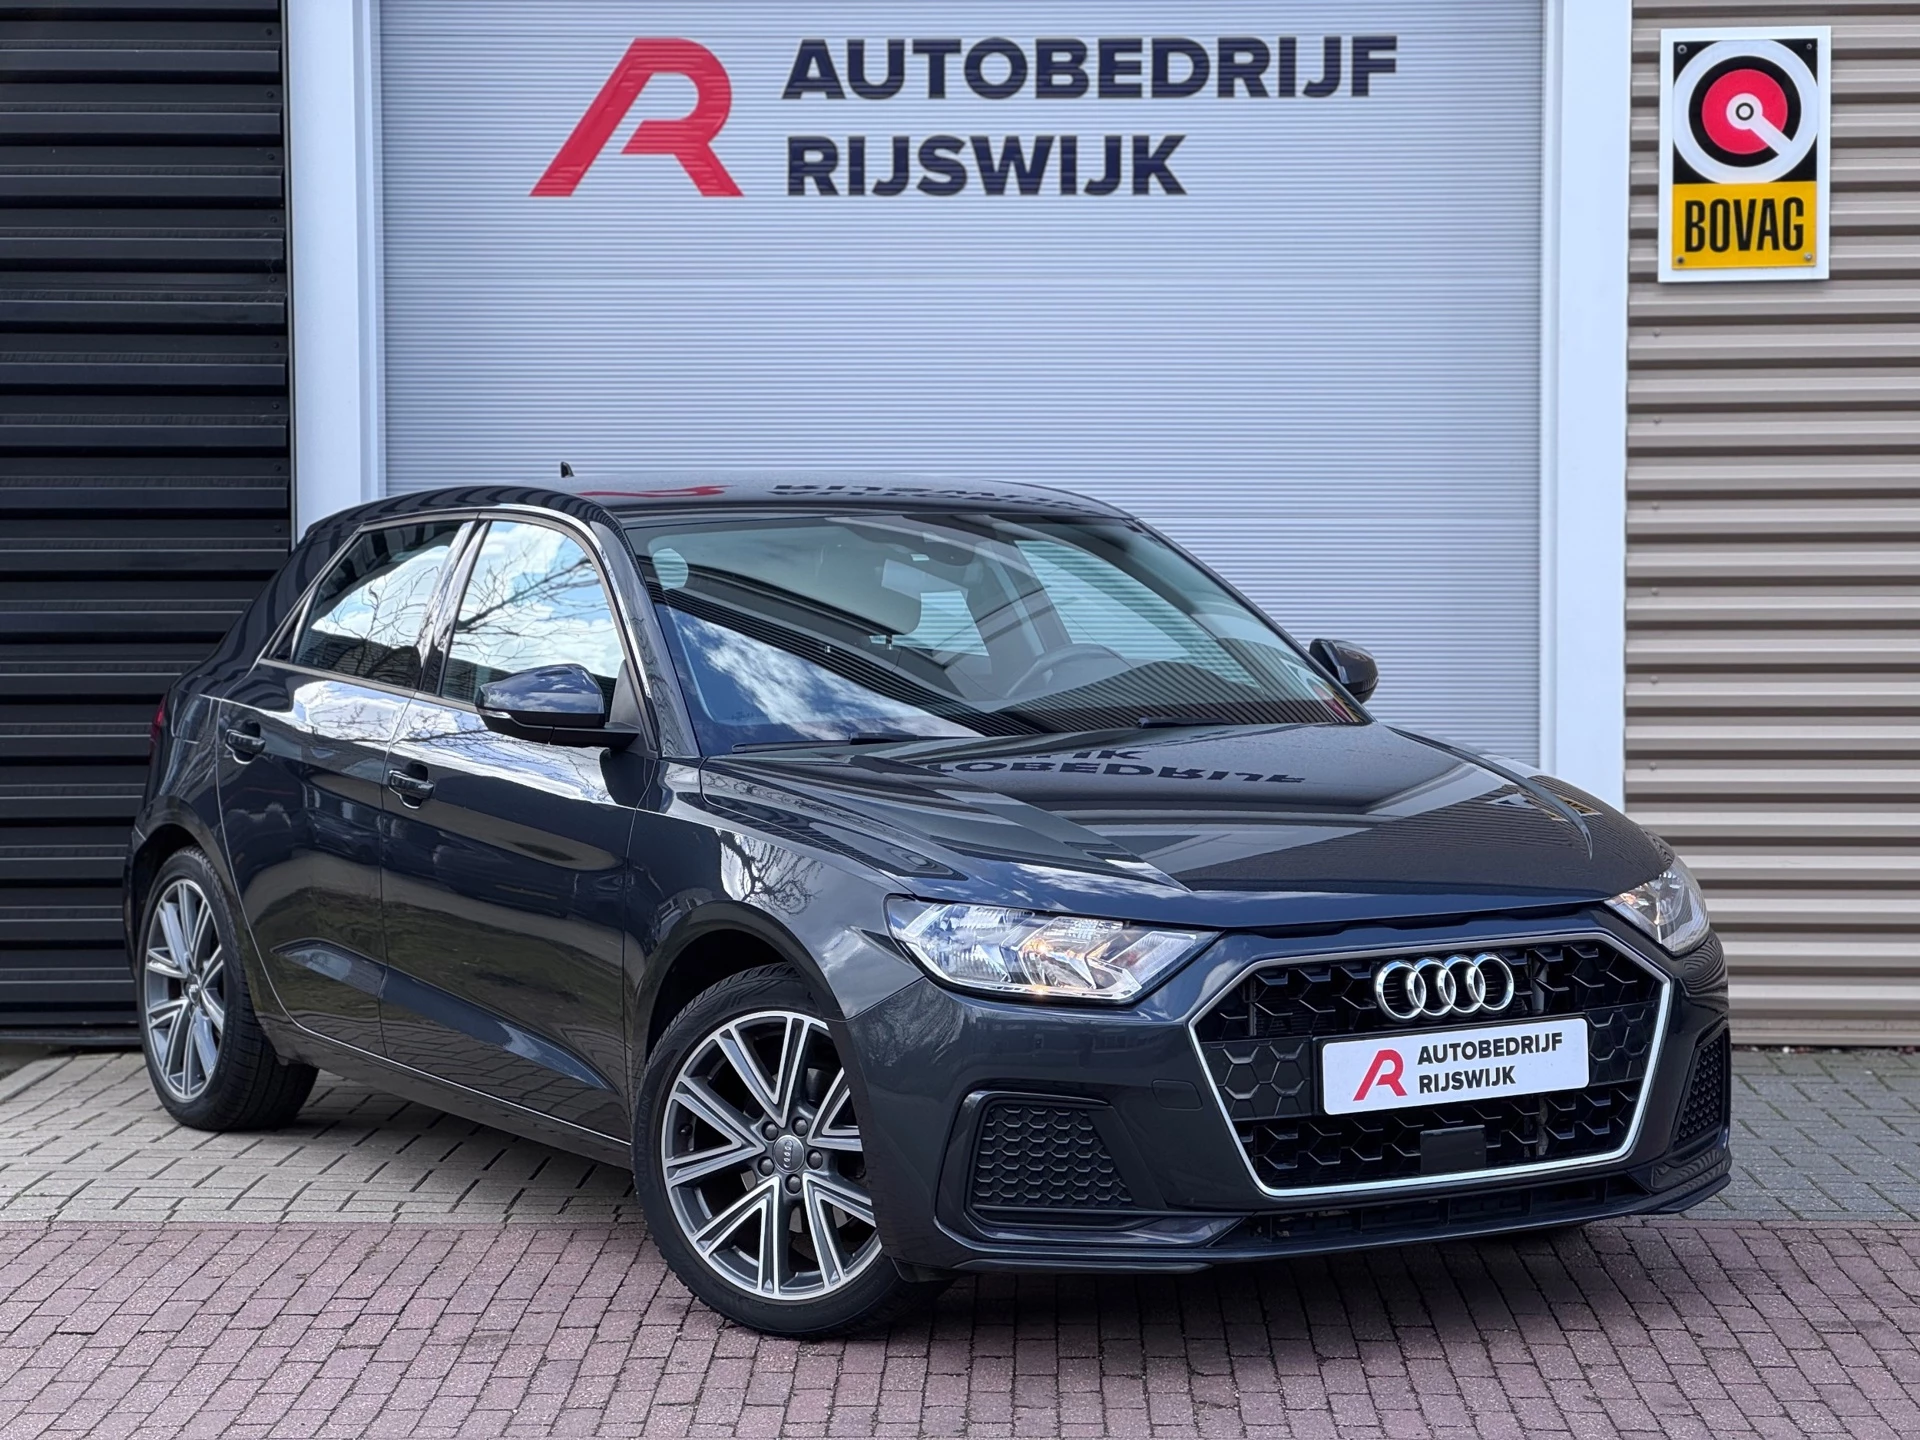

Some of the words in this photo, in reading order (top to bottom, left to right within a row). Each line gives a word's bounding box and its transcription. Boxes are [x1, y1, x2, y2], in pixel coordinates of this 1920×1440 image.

[782, 35, 1398, 100] AUTOBEDRIJF
[787, 135, 1187, 197] RIJSWIJK
[1684, 196, 1804, 253] BOVAG
[1417, 1032, 1563, 1065] AUTOBEDRIJF
[1418, 1065, 1516, 1094] RIJSWIJK
